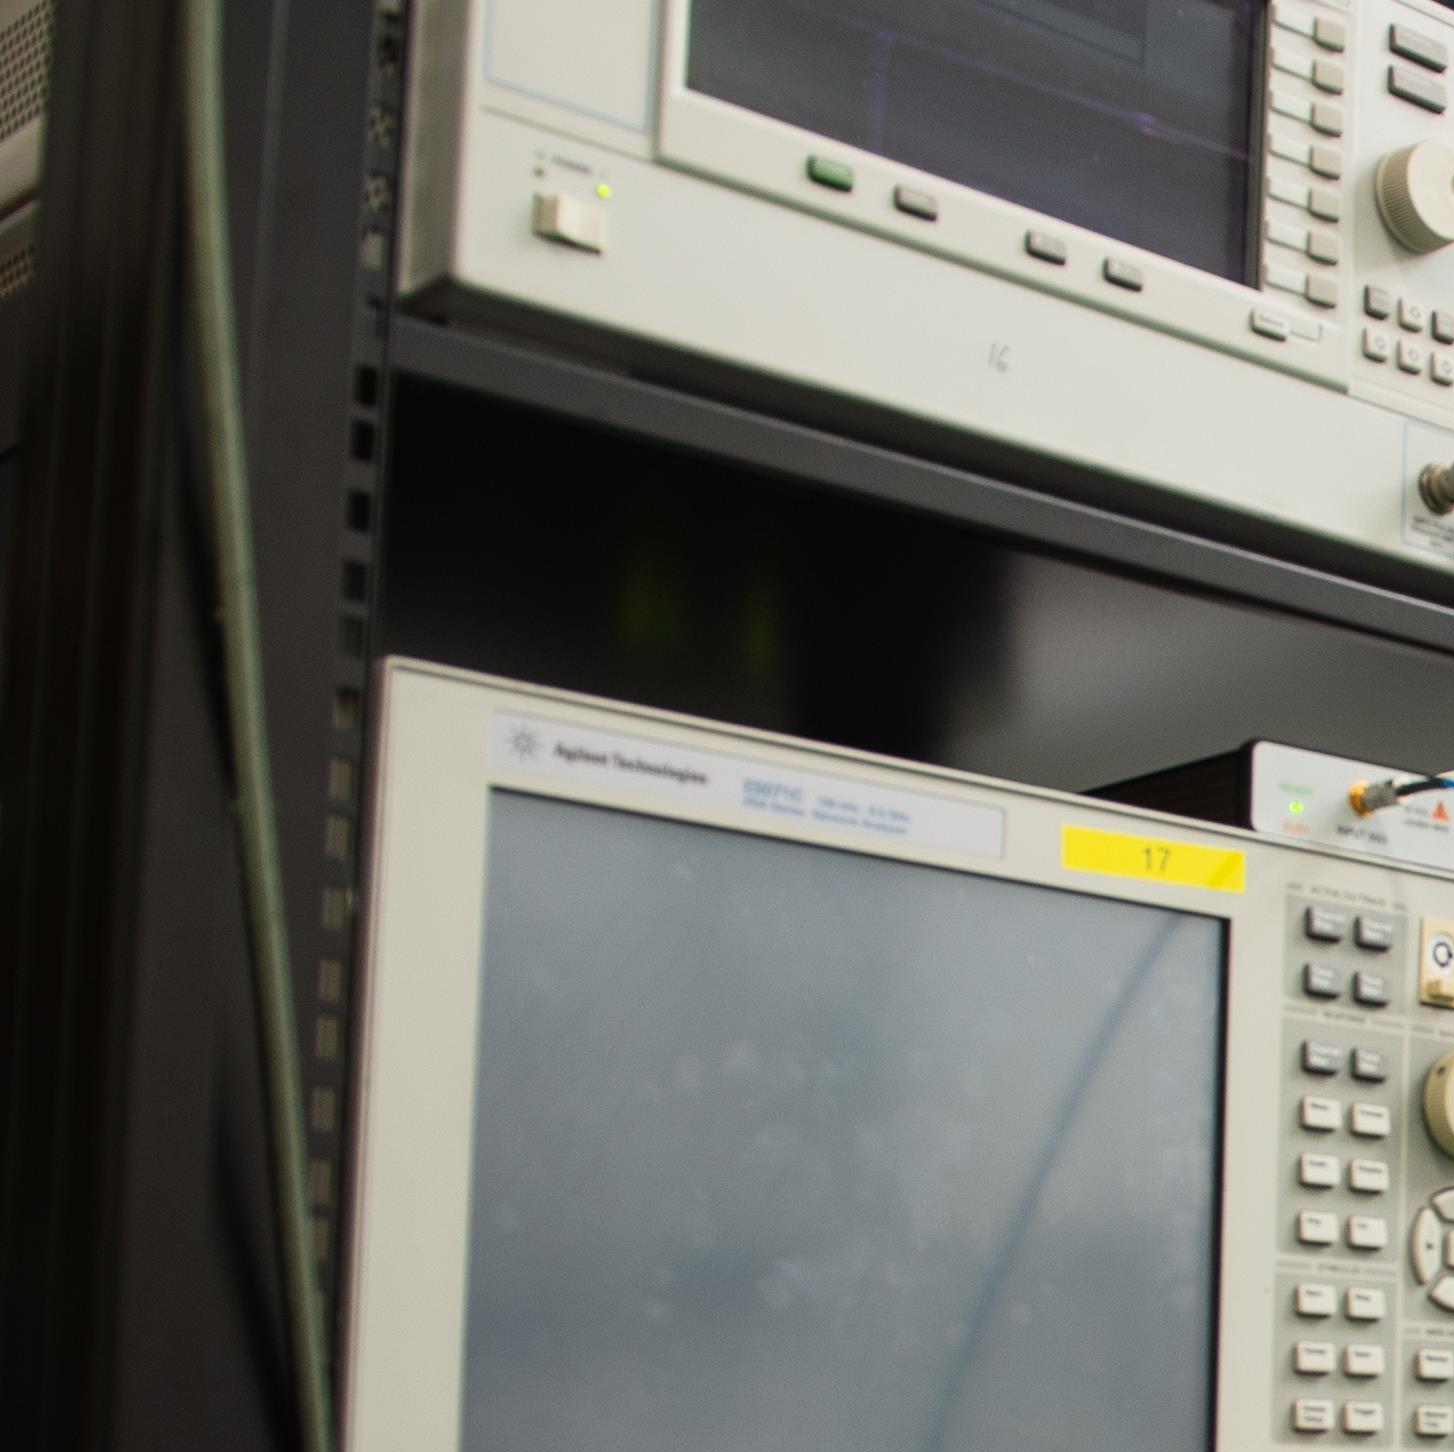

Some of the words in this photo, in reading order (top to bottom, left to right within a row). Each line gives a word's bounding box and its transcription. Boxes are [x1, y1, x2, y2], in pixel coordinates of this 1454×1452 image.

[553, 741, 608, 767] Agilent
[614, 750, 708, 785] Technologies
[1141, 847, 1172, 874] 17
